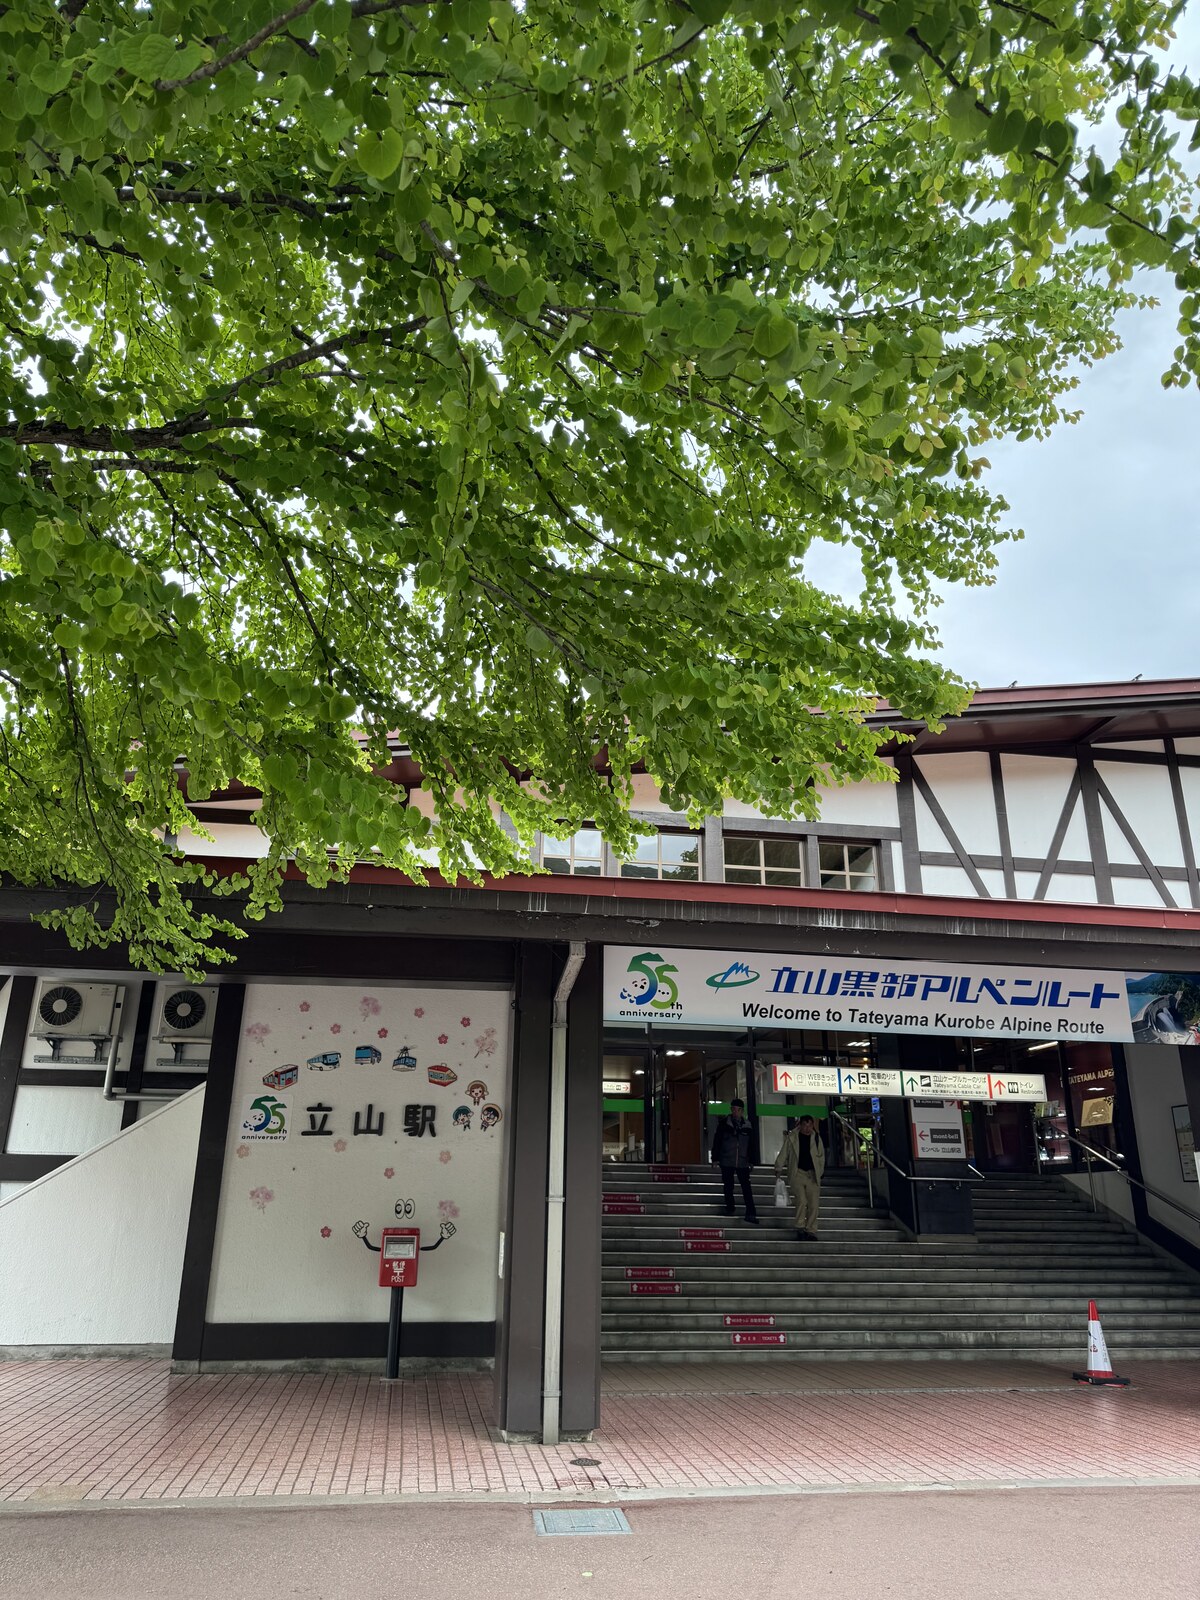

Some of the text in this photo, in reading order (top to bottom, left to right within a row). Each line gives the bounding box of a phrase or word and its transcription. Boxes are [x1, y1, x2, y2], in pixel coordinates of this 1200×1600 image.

[765, 966, 1121, 1009] 立山黒部アルペンルート
[619, 1009, 683, 1020] anniversary
[742, 1002, 1105, 1034] Welcome to Tateyama Kurobe Alpine Route
[301, 1102, 437, 1138] 立山駅
[241, 1134, 287, 1142] anniversary
